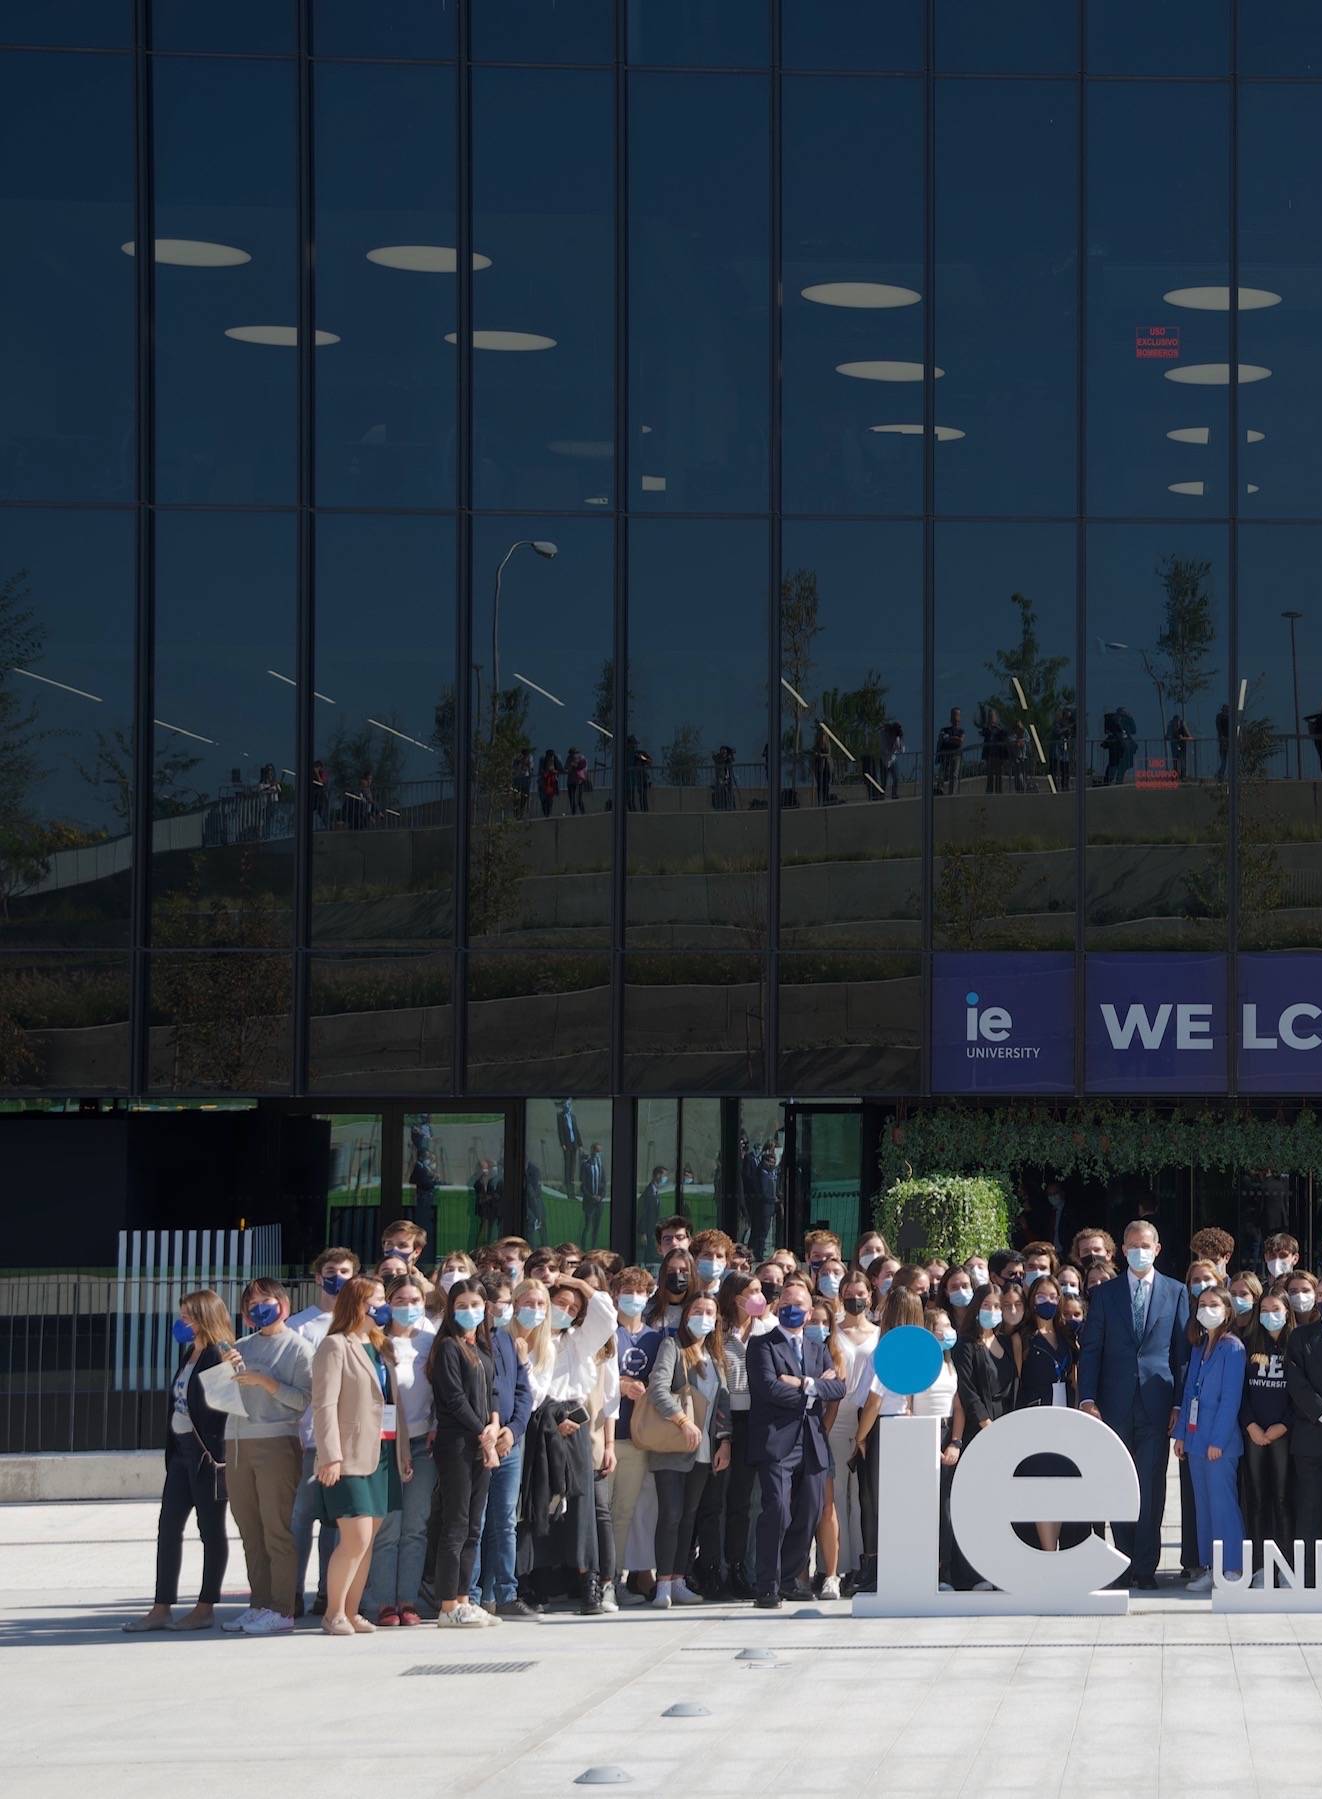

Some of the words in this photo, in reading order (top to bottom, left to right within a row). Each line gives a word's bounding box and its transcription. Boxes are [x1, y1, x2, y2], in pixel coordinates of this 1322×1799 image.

[966, 992, 1013, 1042] ie
[966, 1047, 1041, 1059] UNIVERSITY
[1248, 1378, 1288, 1389] UNIVERSIT
[873, 1324, 1141, 1592] ie
